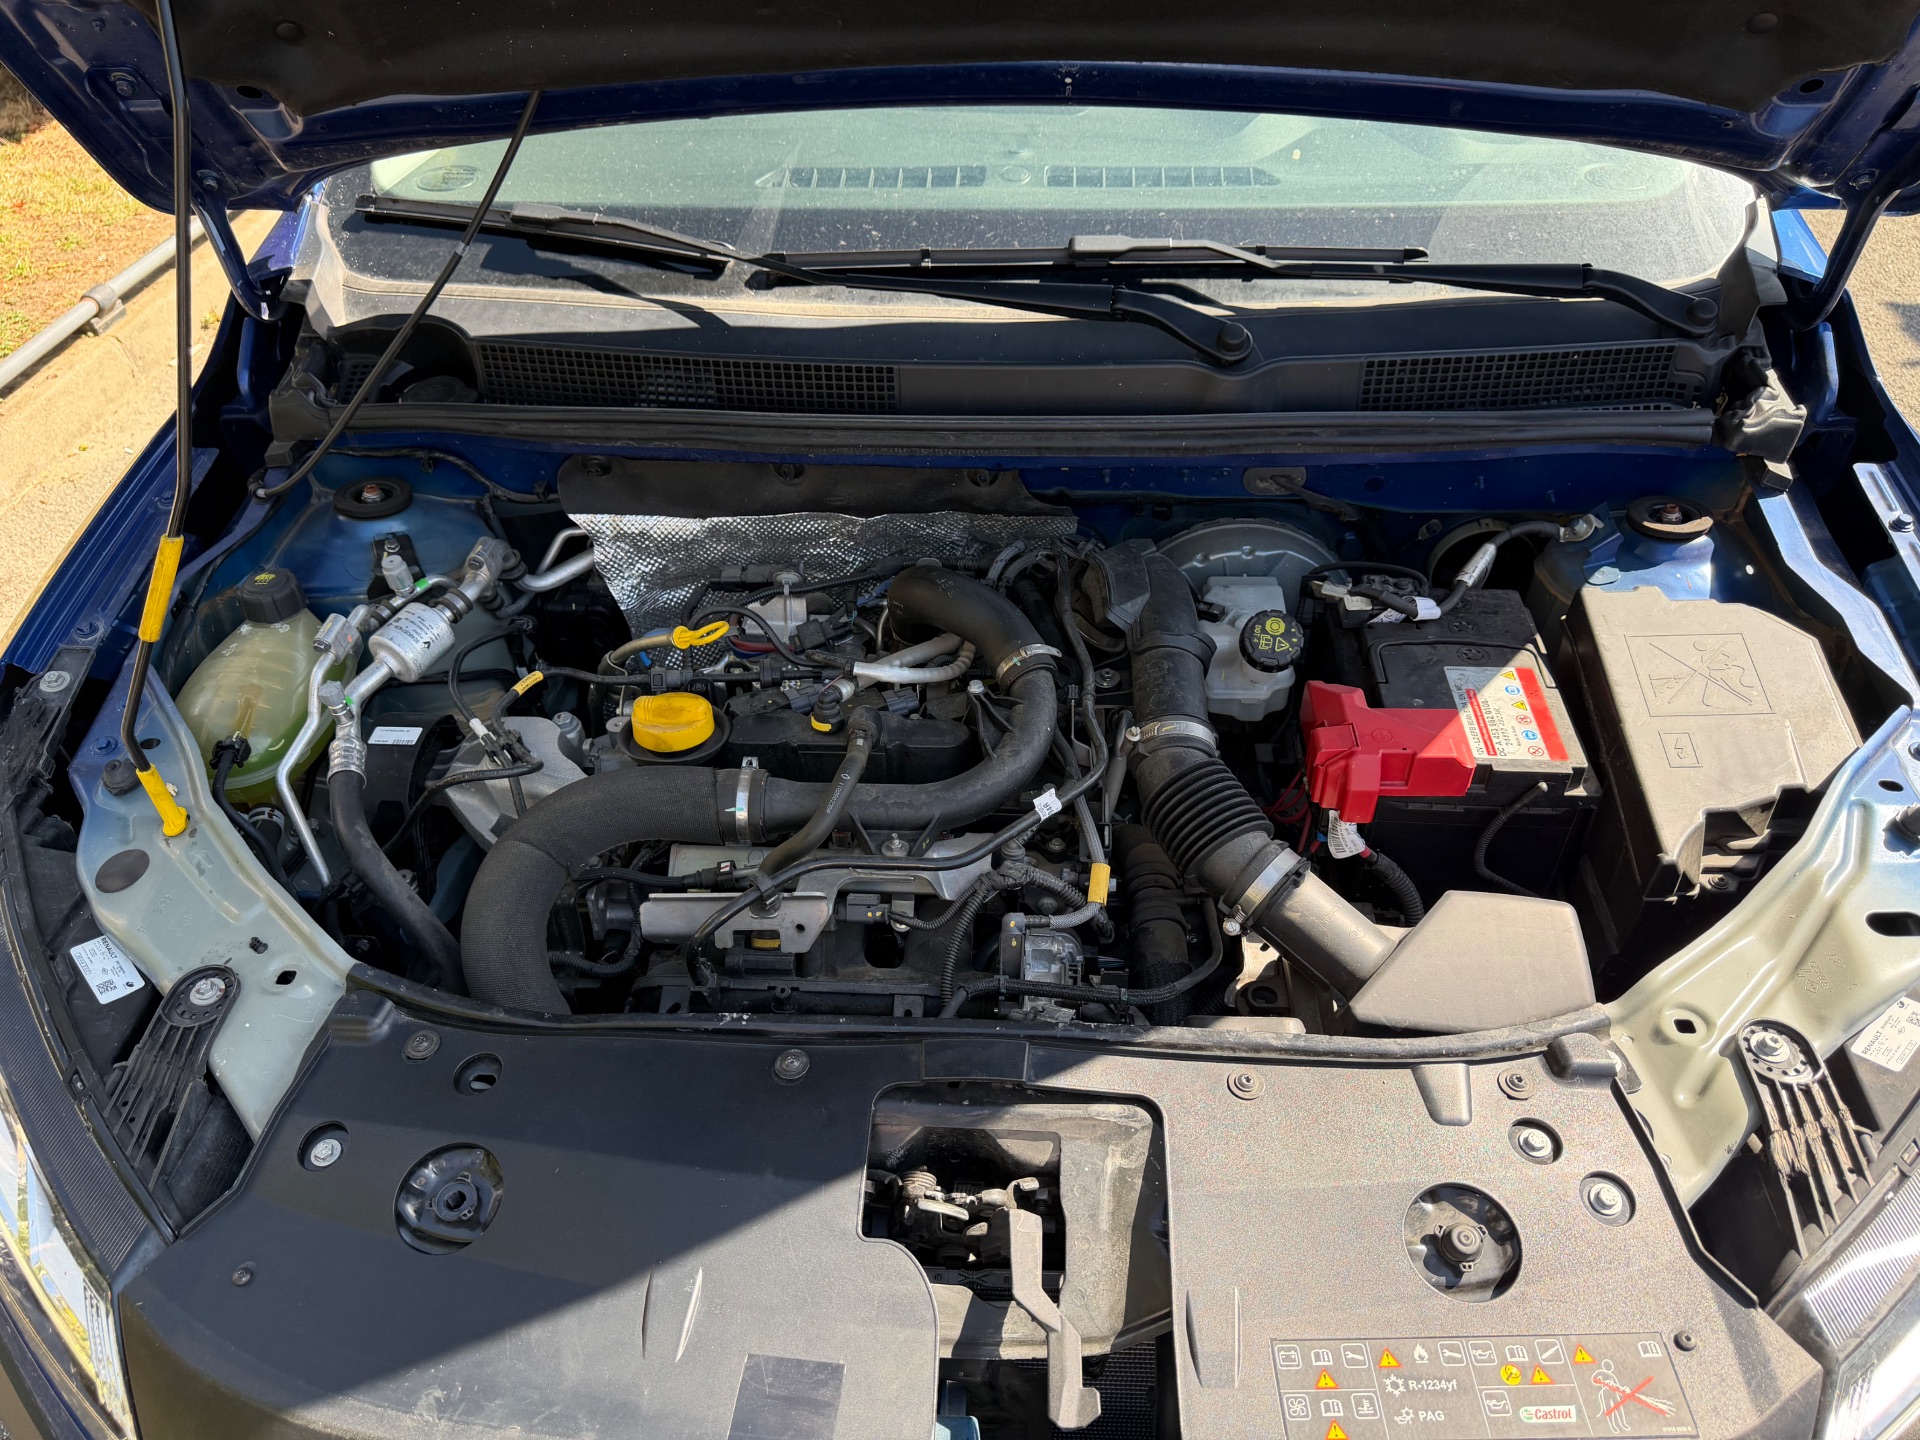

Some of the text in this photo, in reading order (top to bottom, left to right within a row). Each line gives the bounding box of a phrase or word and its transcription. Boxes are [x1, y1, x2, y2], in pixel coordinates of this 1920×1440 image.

[1469, 726, 1478, 736] EFB
[1497, 747, 1507, 756] DC
[100, 937, 118, 960] RENAULT
[1861, 1030, 1883, 1055] RENAULT
[1408, 1378, 1458, 1393] R-1234yf
[1418, 1409, 1445, 1423] PAG
[1534, 1408, 1572, 1420] Castrol
